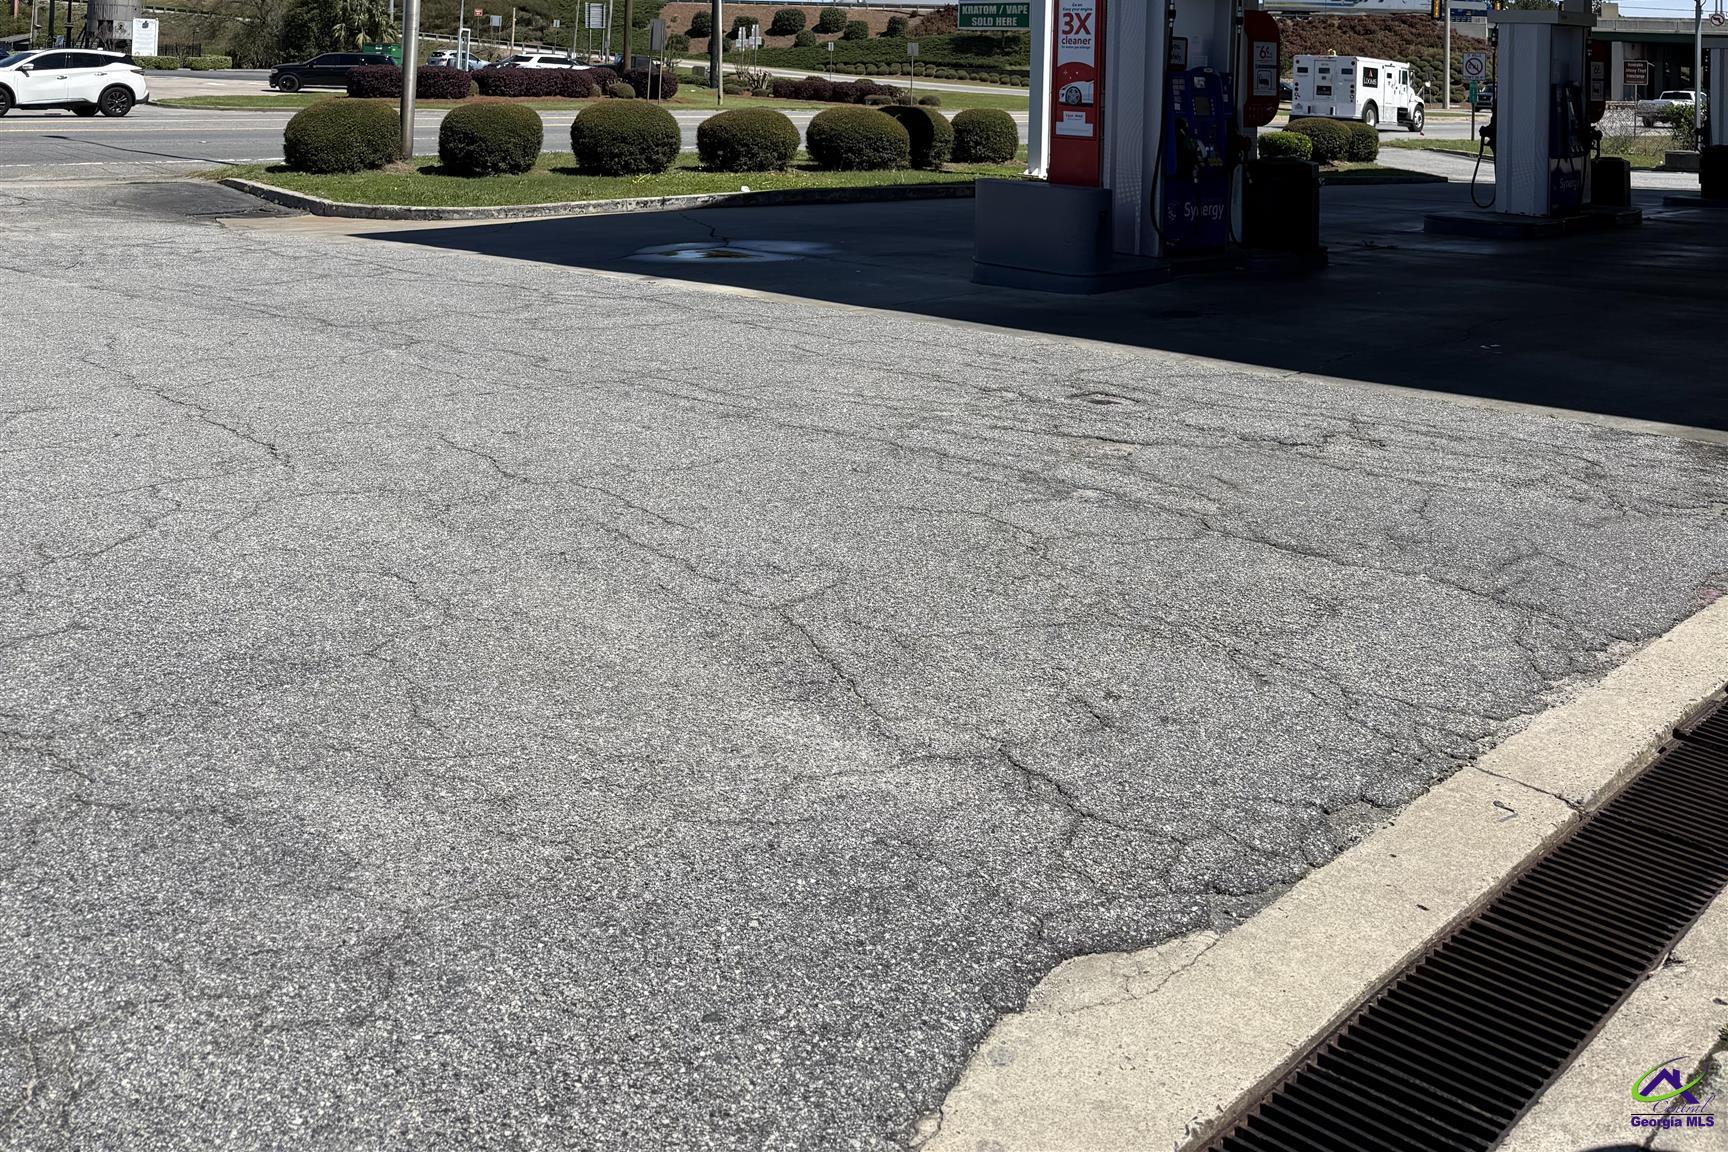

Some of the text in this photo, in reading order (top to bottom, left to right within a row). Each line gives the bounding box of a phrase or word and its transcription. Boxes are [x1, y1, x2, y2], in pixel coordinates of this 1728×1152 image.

[962, 5, 997, 15] KRATOM
[1006, 4, 1028, 15] VAPE
[971, 17, 1018, 26] SOLD HERE
[1061, 12, 1092, 35] 3X
[1061, 36, 1092, 45] cleaner
